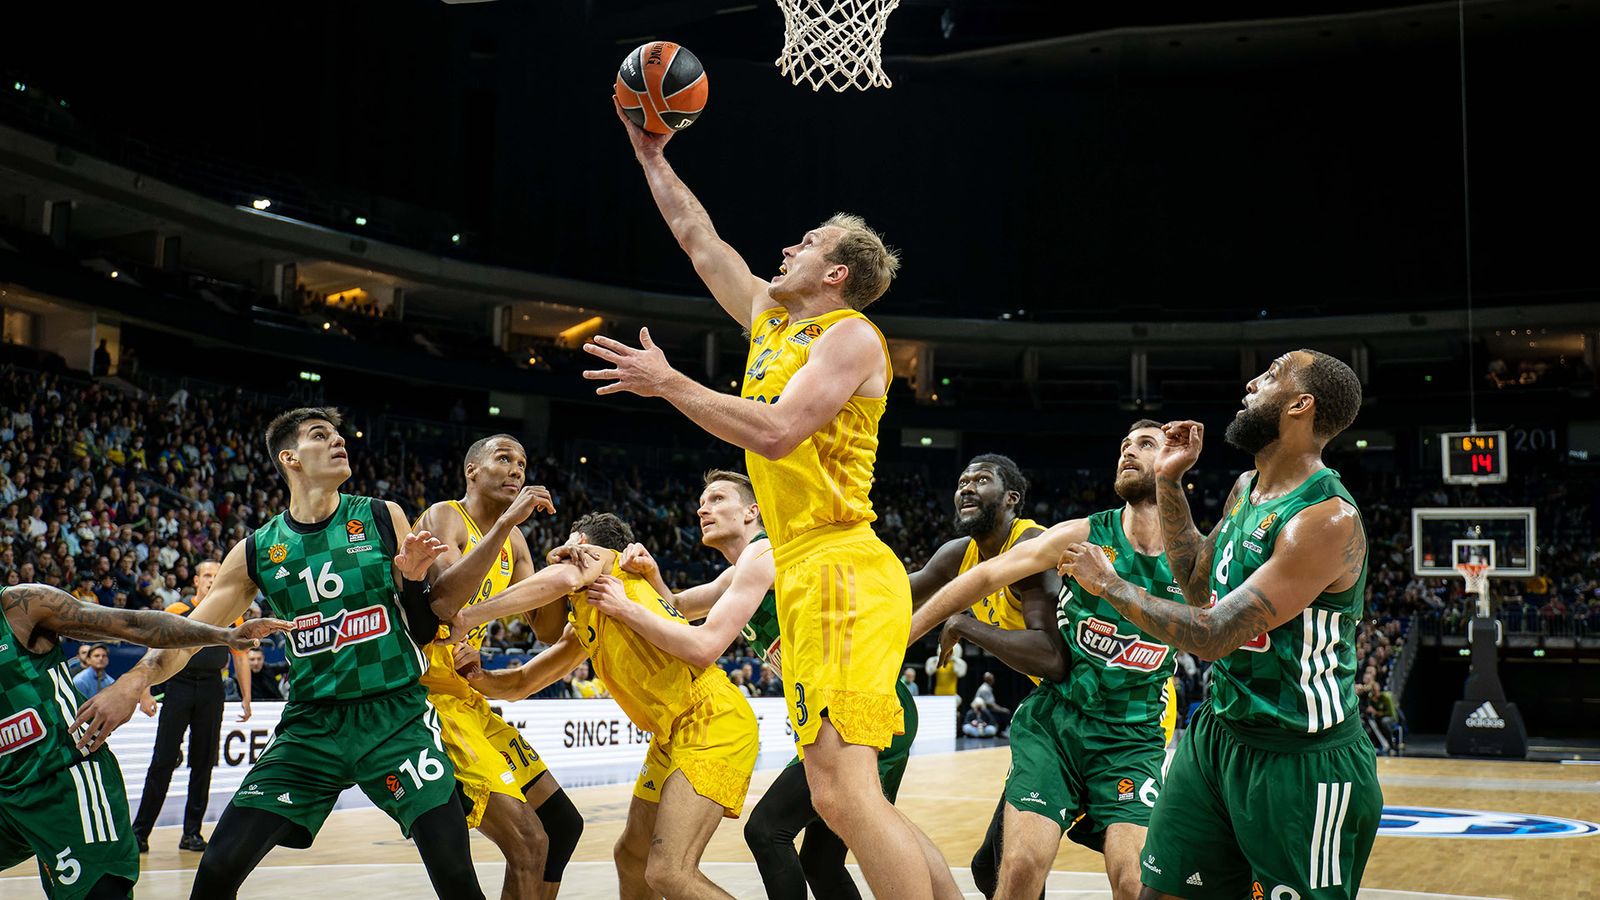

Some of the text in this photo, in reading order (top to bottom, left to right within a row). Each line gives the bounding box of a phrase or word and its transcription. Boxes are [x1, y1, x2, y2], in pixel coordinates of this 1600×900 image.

[1514, 428, 1556, 451] 201
[1471, 453, 1493, 473] 14
[298, 560, 344, 603] 16
[1216, 540, 1234, 585] 8
[795, 682, 808, 726] 3
[564, 720, 619, 748] SINCE
[398, 748, 445, 790] 16
[1138, 776, 1160, 808] 6
[55, 846, 81, 885] 5
